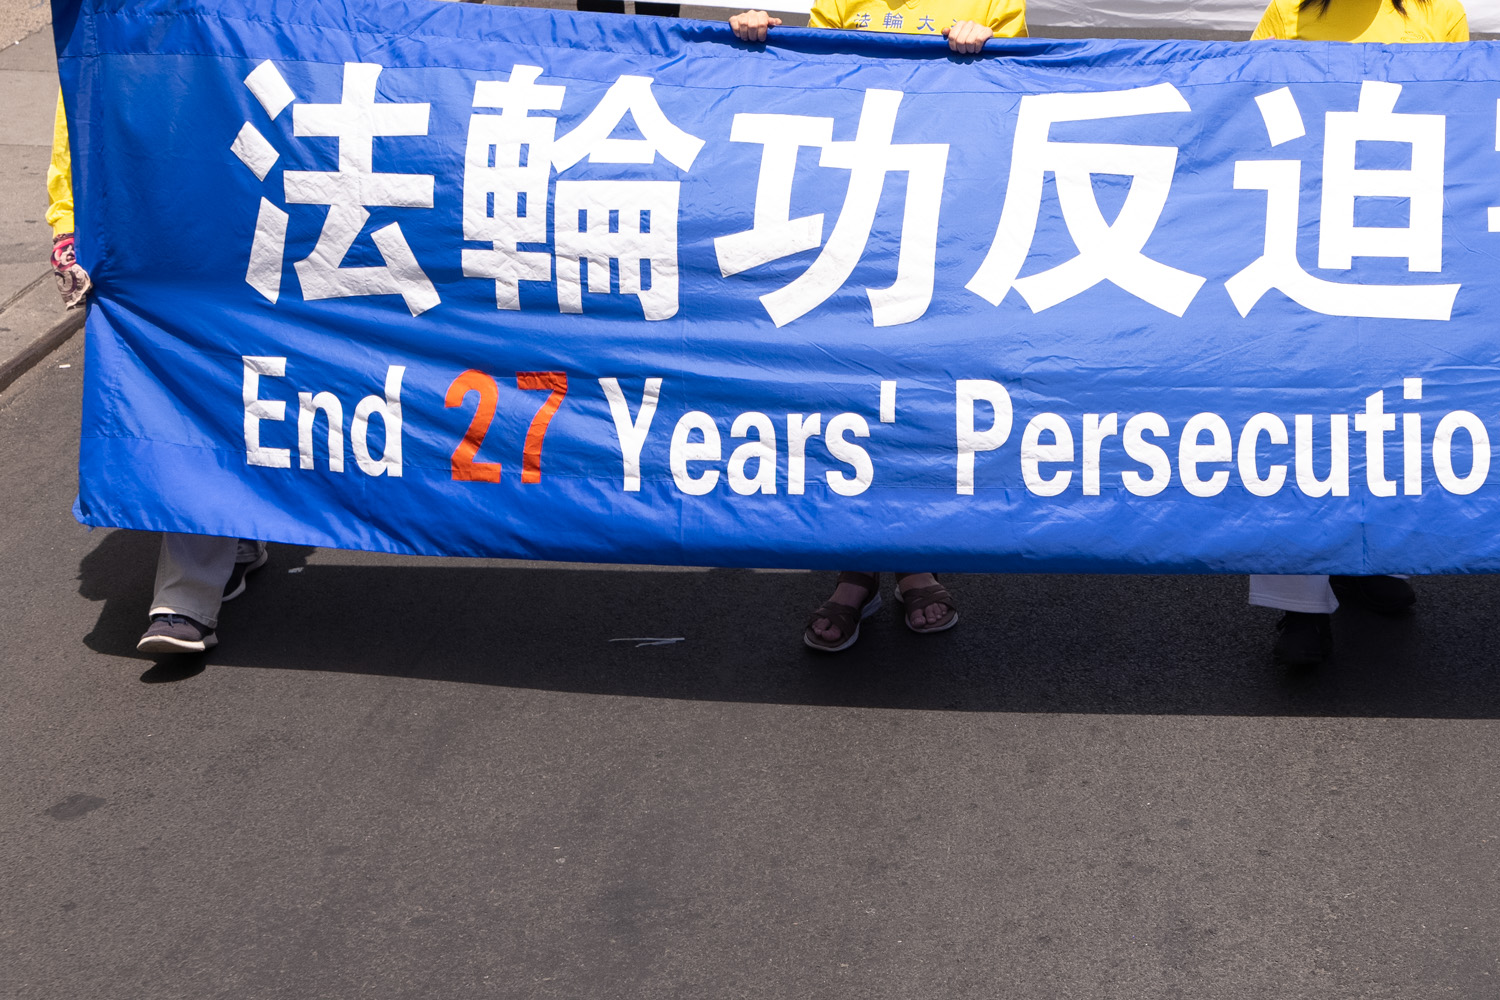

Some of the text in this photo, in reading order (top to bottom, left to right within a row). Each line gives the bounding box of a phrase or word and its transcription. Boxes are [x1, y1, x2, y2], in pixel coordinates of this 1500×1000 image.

[854, 12, 956, 32] 法輪大
[242, 355, 407, 478] End
[445, 369, 568, 484] 27
[598, 377, 898, 497] Years'
